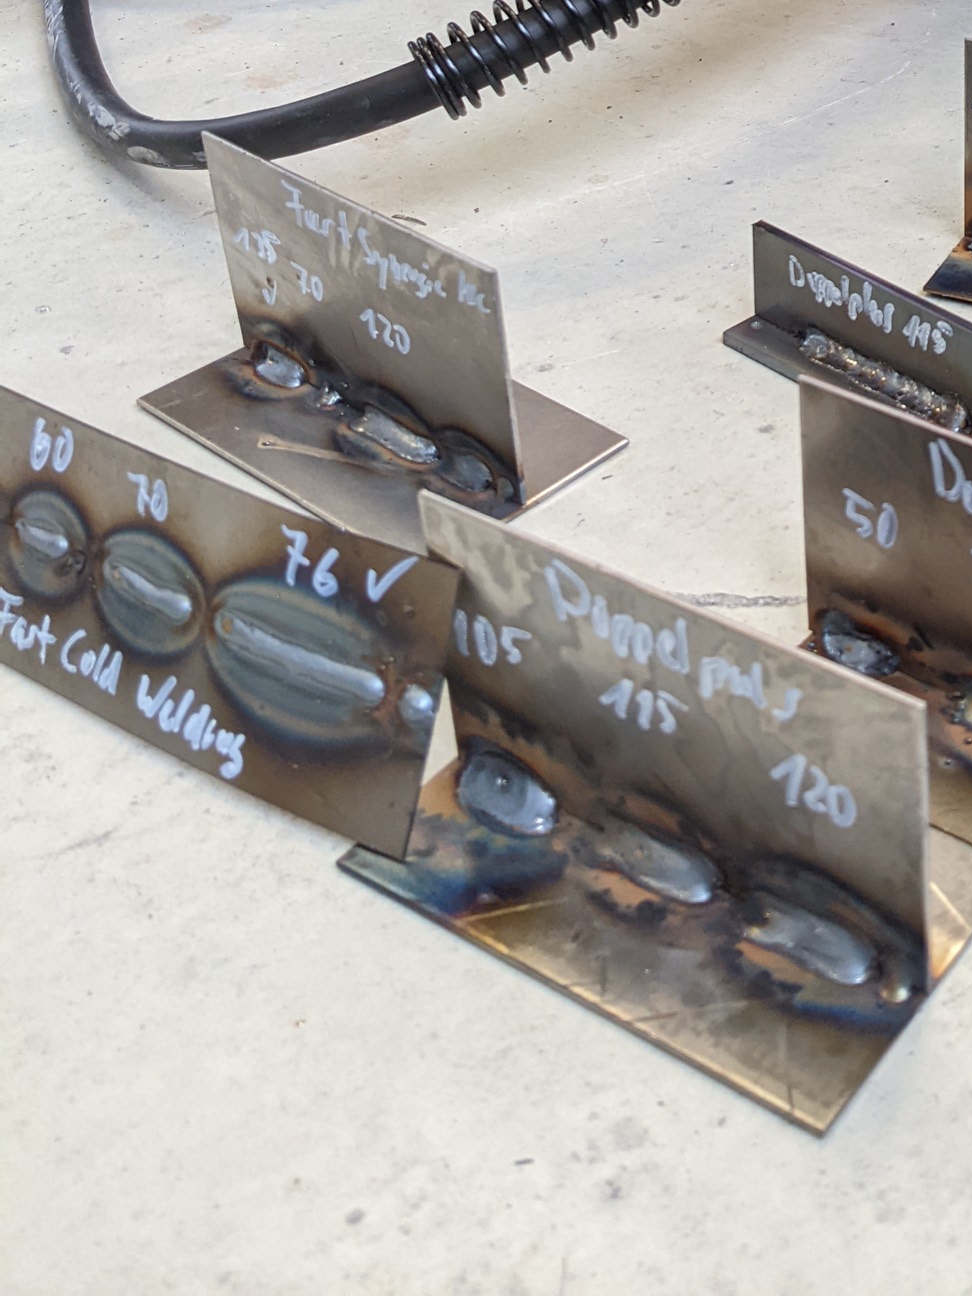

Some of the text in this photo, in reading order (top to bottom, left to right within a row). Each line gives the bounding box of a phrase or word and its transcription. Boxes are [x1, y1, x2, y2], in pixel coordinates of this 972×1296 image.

[359, 308, 411, 355] 120
[29, 417, 74, 473] 60
[127, 471, 169, 522] 70
[841, 487, 899, 549] 50
[280, 523, 341, 597] 76
[60, 628, 123, 696] Cold
[452, 608, 533, 667] 105
[769, 753, 858, 829] 120
